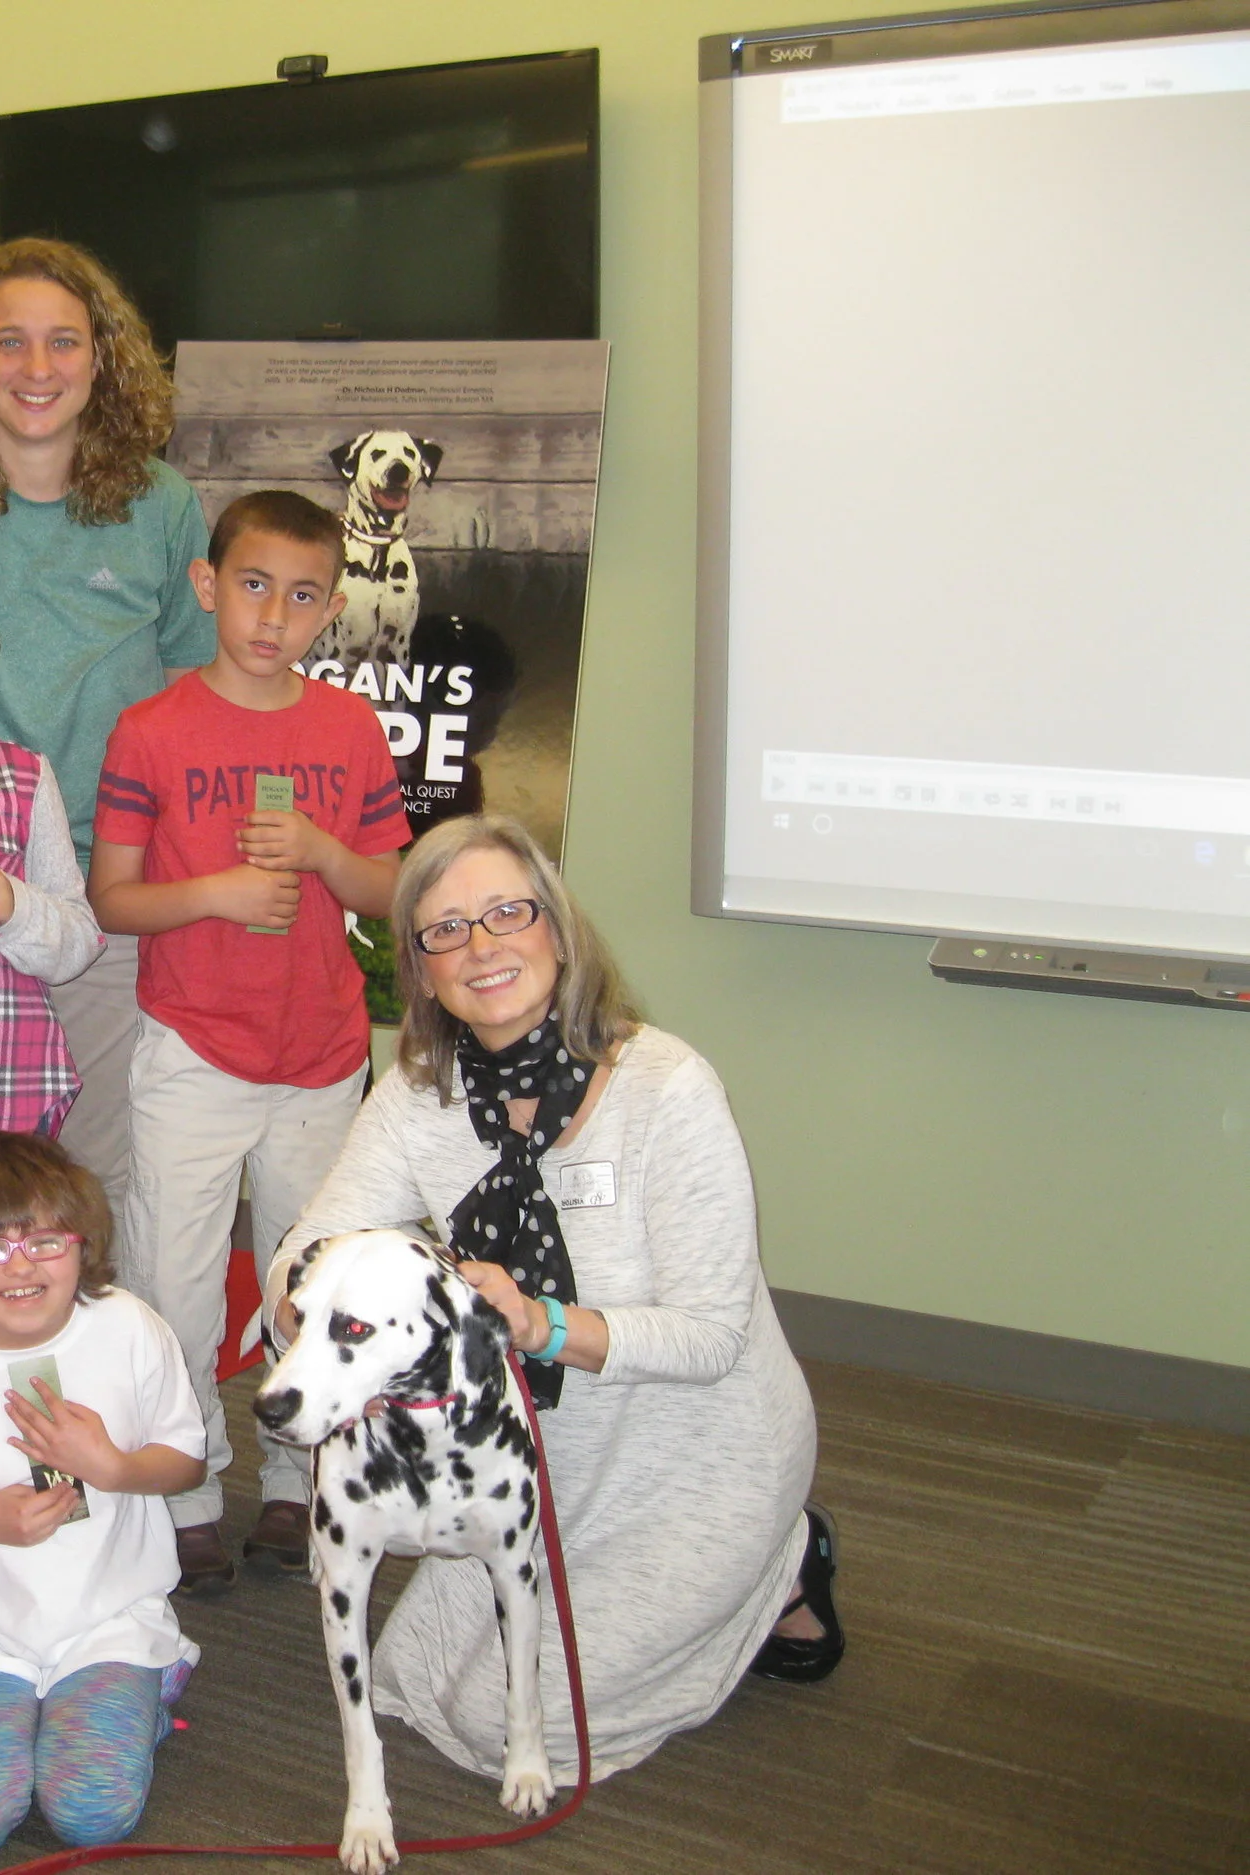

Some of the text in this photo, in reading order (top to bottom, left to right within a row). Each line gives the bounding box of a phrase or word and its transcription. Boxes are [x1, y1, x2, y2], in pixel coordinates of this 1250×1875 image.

[770, 45, 818, 63] SMART
[353, 386, 385, 395] Nicholas
[288, 660, 474, 706] GAN'S
[374, 710, 468, 783] PE
[186, 764, 346, 824] PATOTS
[400, 784, 457, 799] AL QUEST
[403, 801, 431, 814] NCE
